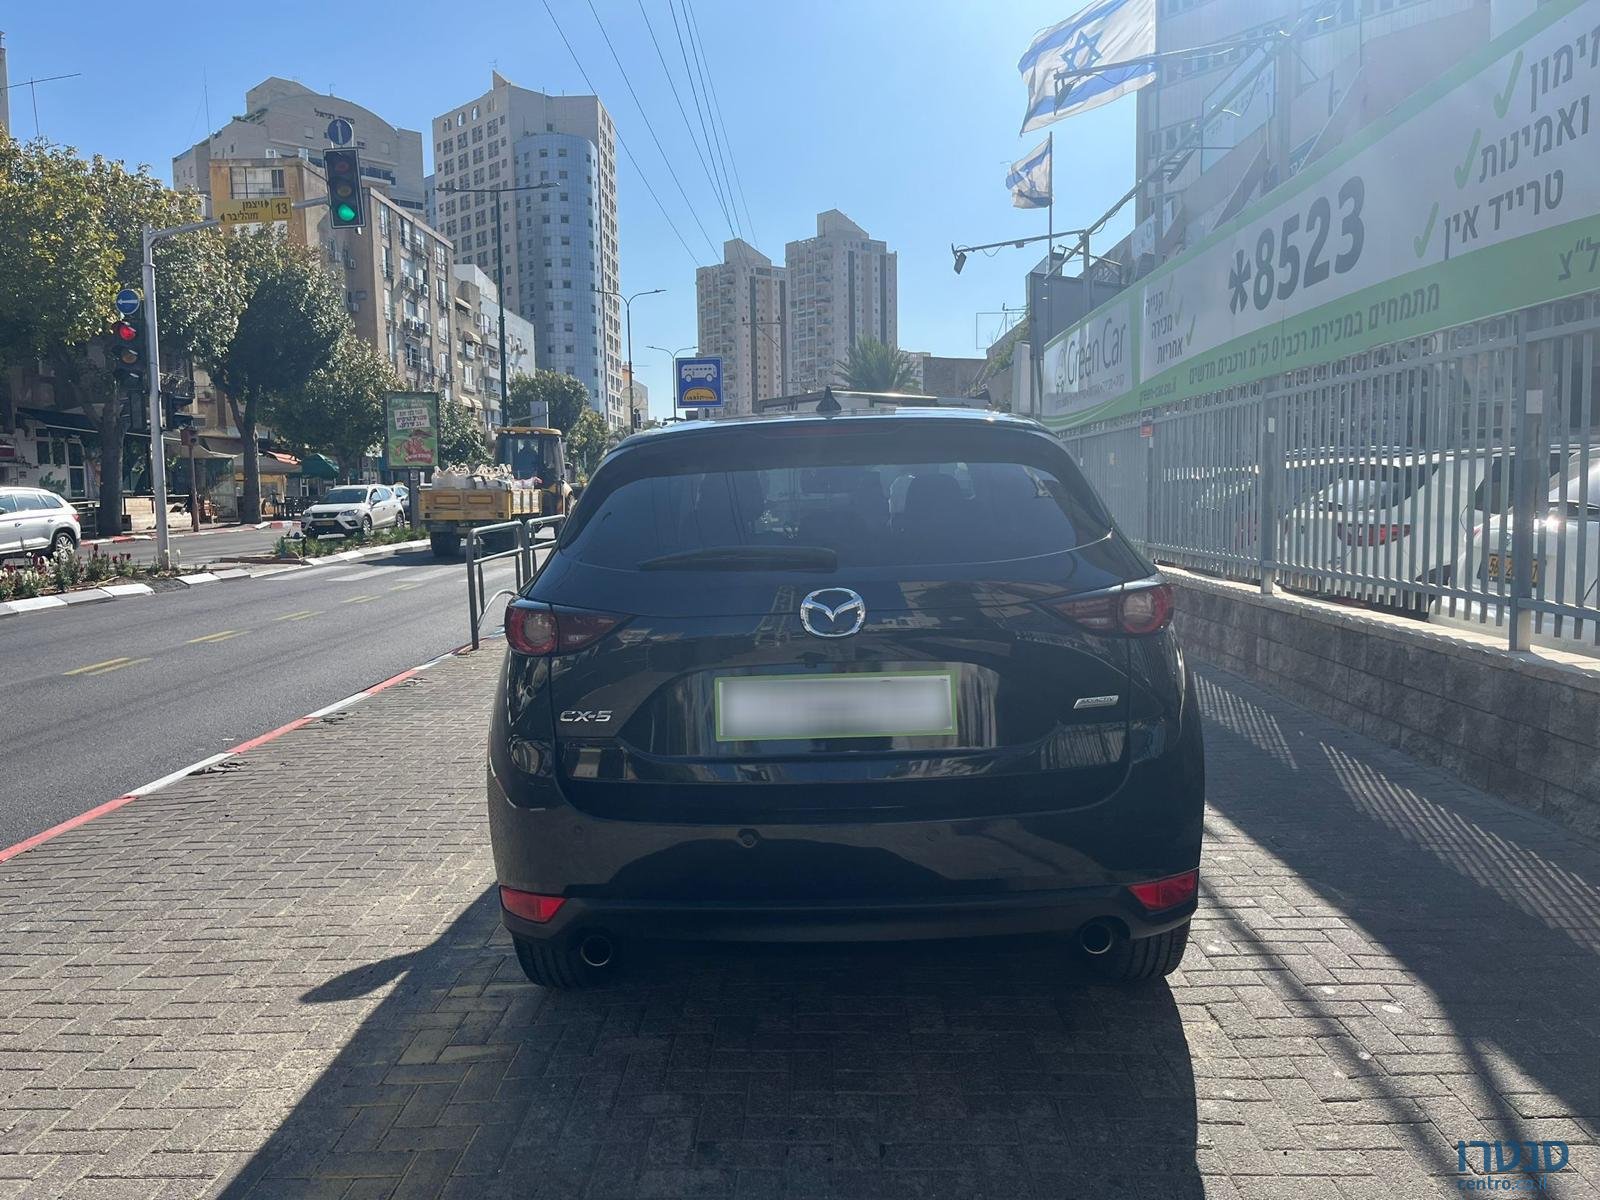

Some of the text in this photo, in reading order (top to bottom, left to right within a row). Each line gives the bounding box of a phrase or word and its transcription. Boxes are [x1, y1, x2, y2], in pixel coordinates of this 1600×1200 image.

[1479, 95, 1590, 184] ואמינות
[242, 200, 264, 211] ויצמן
[274, 202, 288, 215] 13
[1444, 169, 1564, 260] טרייד אין
[1368, 282, 1440, 331] מתמחים
[1151, 314, 1173, 340] מכירה
[1310, 310, 1363, 349] במכירת
[1067, 317, 1127, 385] Green Car
[1156, 337, 1183, 364] אחריות
[1281, 330, 1307, 357] רכבי
[1189, 361, 1216, 385] חדשים
[1217, 350, 1247, 377] ורכבים
[560, 710, 614, 722] CX-5
